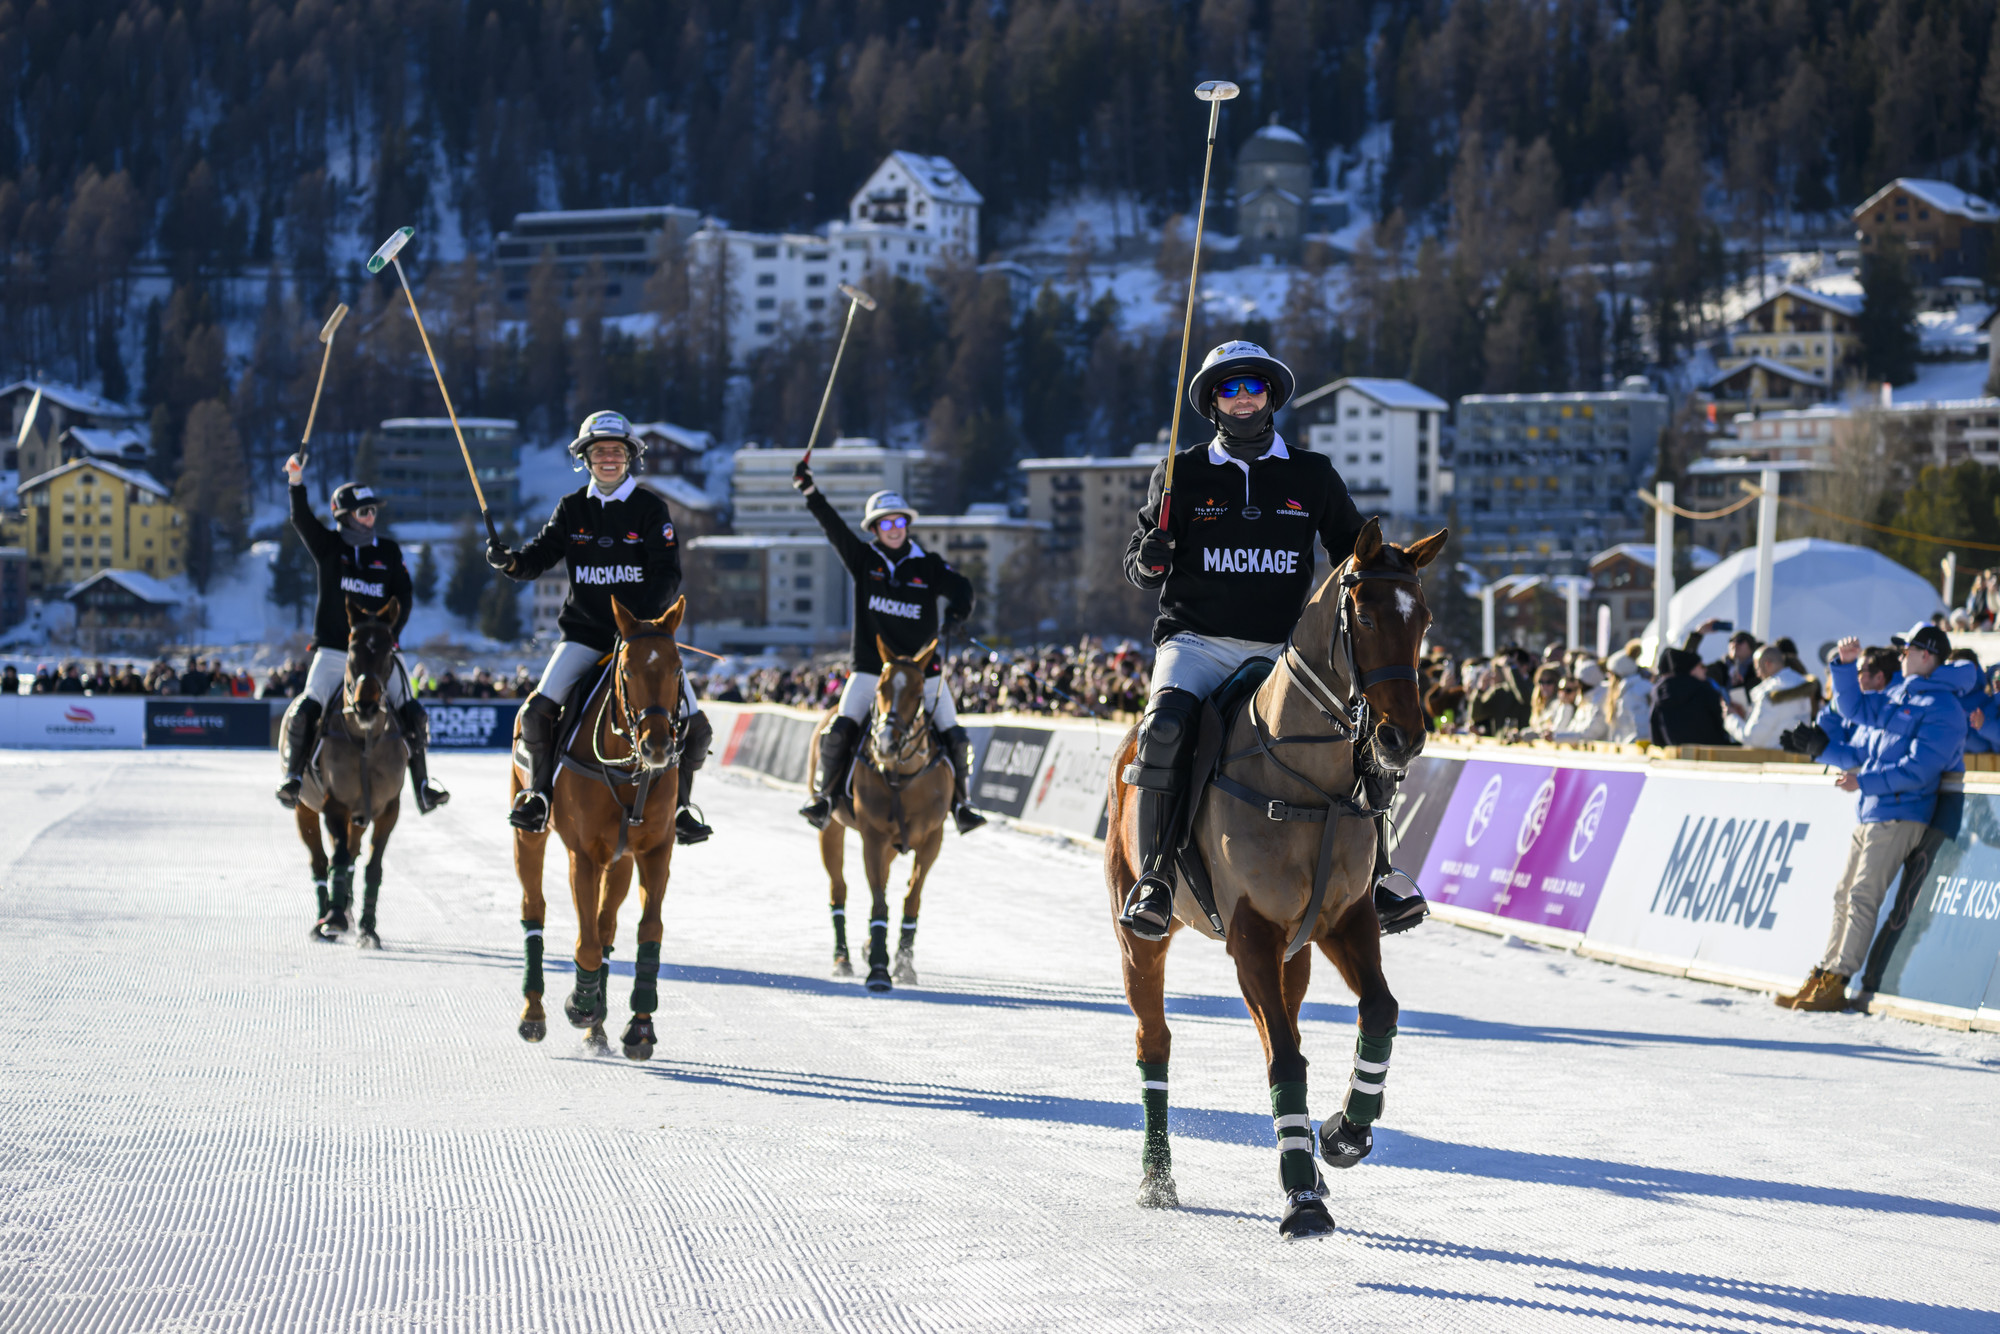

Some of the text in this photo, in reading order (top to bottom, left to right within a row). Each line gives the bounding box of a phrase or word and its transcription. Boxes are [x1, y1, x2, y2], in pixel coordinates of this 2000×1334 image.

[1276, 509, 1310, 518] casablanca
[1203, 547, 1300, 574] MACKAGE
[340, 576, 384, 598] MACKAGE
[575, 565, 644, 585] MACKAGE
[868, 594, 922, 620] MACKAGE
[1650, 814, 1810, 930] MACKAGE
[1541, 876, 1586, 898] WORLD POLO
[1929, 875, 1968, 915] THE
